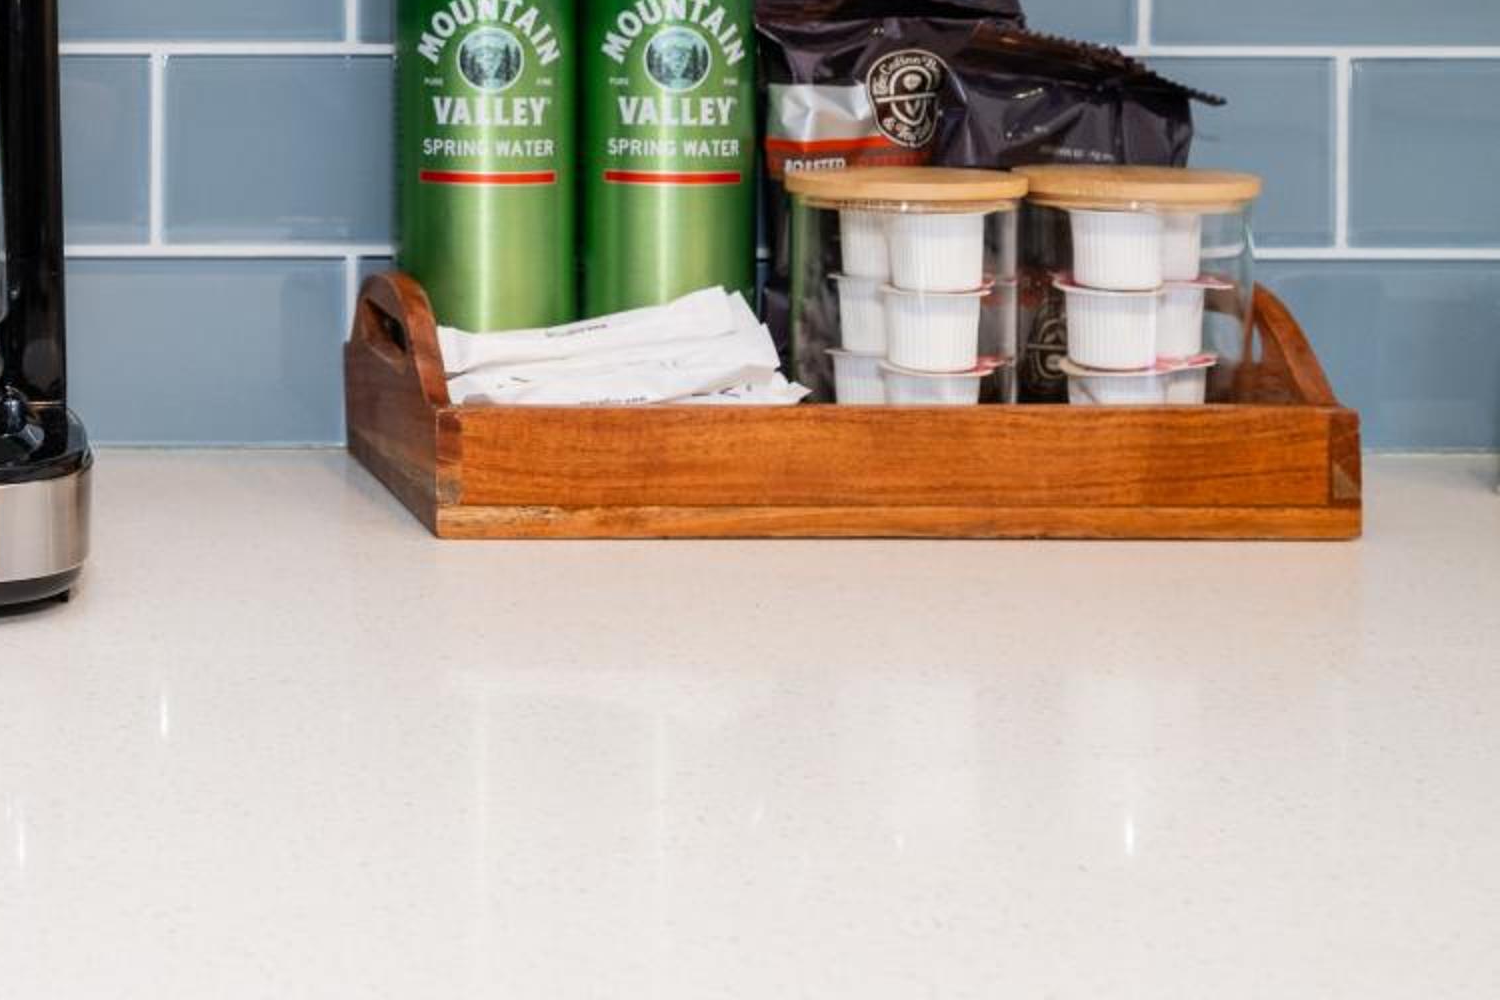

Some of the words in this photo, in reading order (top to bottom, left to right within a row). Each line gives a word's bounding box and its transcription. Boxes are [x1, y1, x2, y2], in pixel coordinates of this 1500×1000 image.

[432, 95, 548, 126] VALLEY
[617, 95, 733, 126] VALLEY
[422, 138, 488, 157] SPRING
[495, 138, 554, 157] WATER
[607, 138, 677, 157] SPRING
[683, 138, 740, 157] WATER
